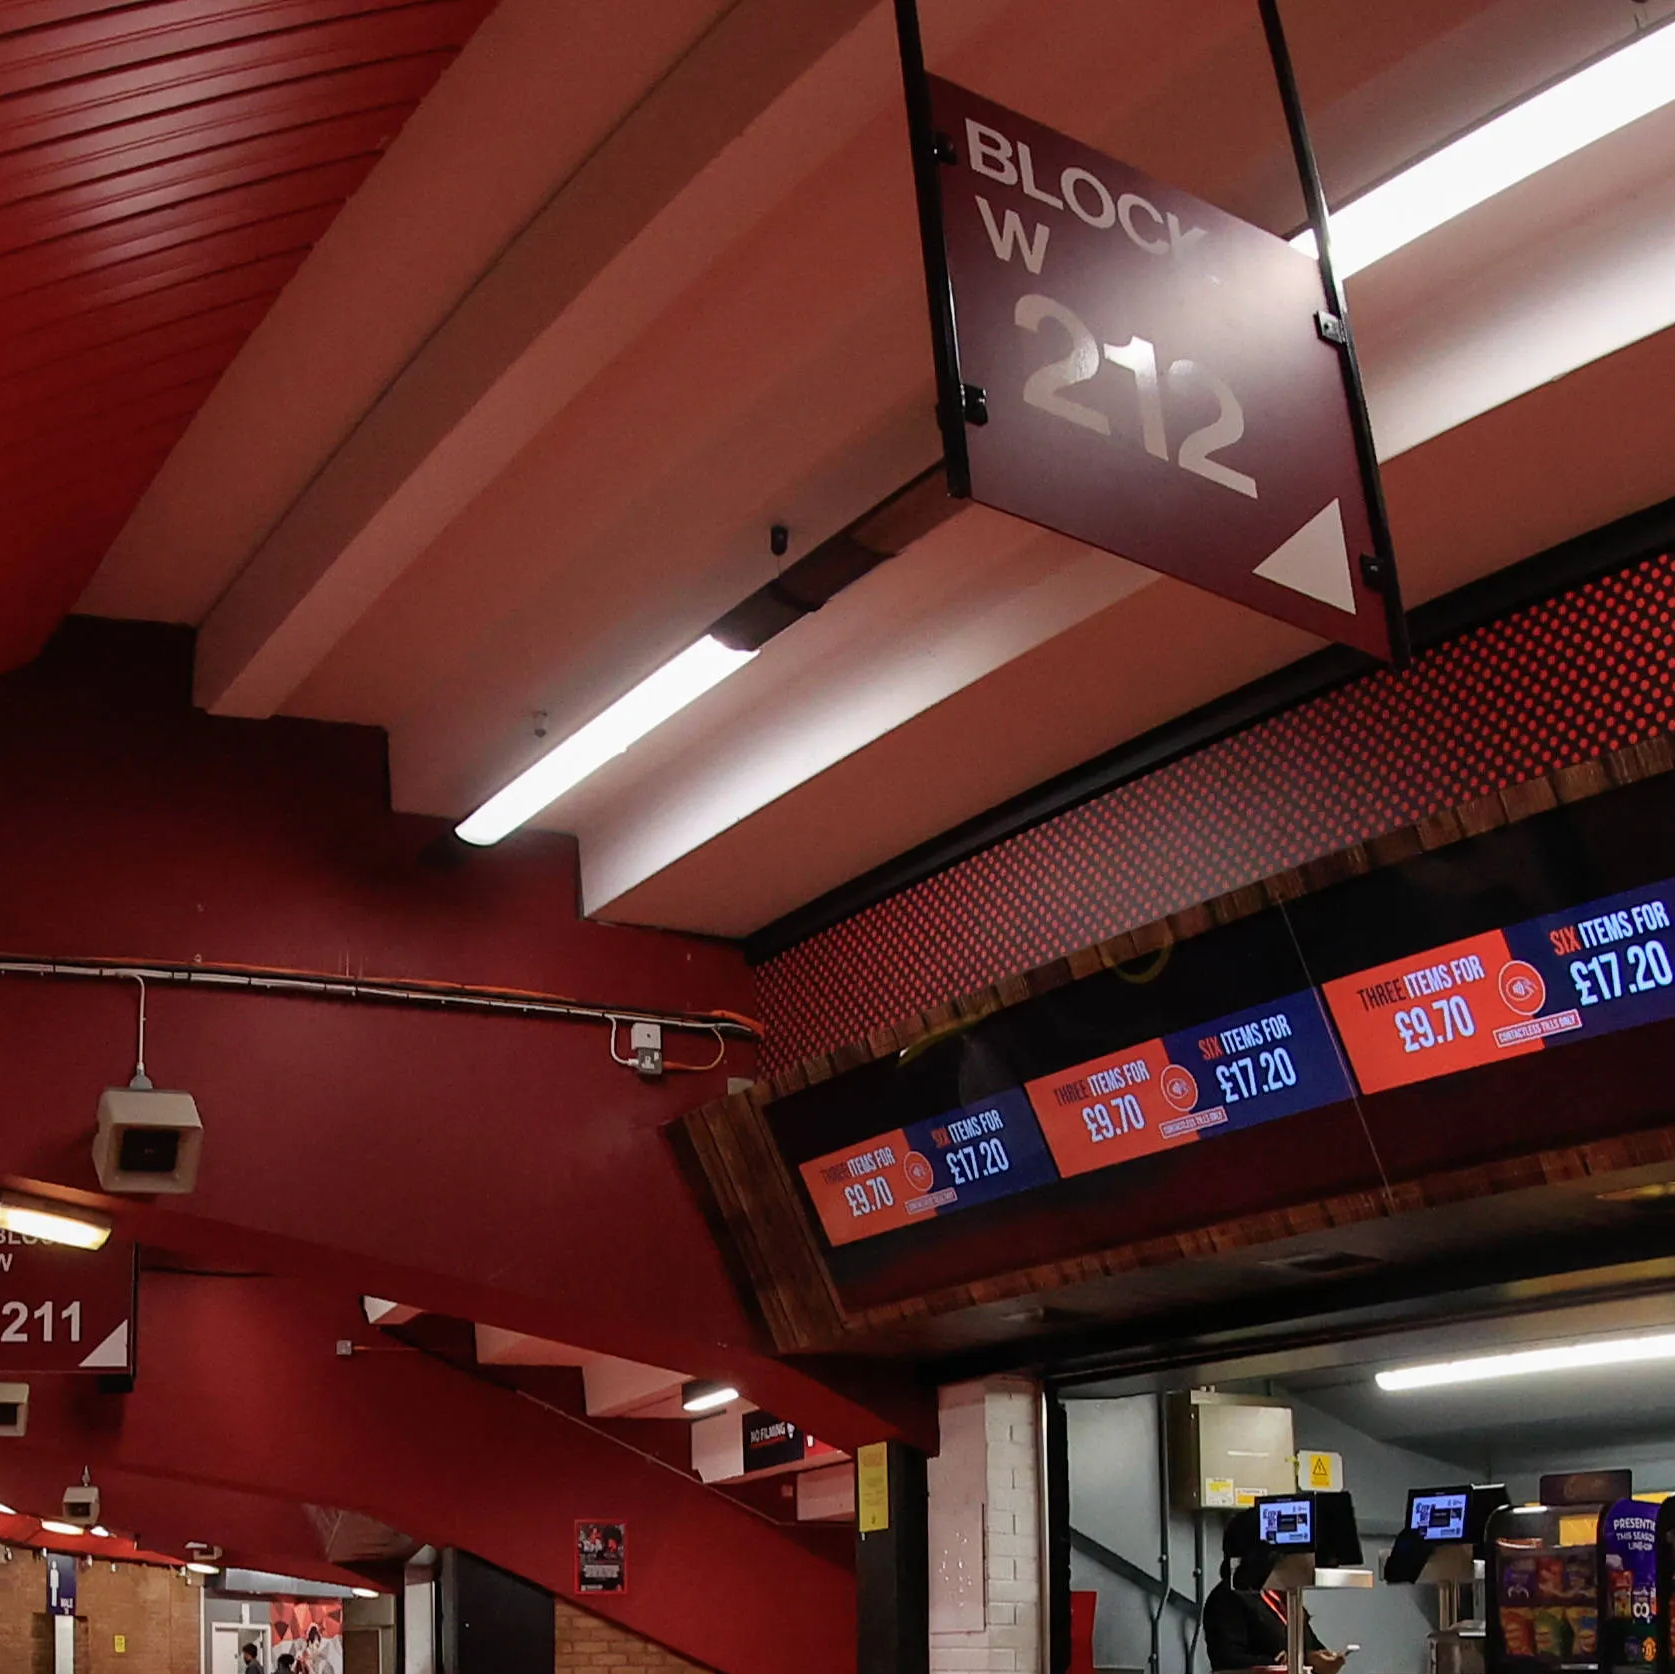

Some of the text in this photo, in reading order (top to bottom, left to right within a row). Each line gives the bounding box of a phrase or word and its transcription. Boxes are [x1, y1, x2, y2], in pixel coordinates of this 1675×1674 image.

[965, 117, 1220, 286] BLOCK
[976, 195, 1050, 274] W
[1014, 294, 1258, 499] 212
[1549, 900, 1671, 957] SIX ITEMS FOR
[1356, 954, 1486, 1011] THREE ITEMS FOR
[1569, 939, 1674, 1007] £17.20
[1198, 1013, 1293, 1061] SIX ITEMS FOR
[1393, 995, 1476, 1053] £9.70
[1053, 1060, 1151, 1106] THREE ITEMS FOR
[1215, 1047, 1297, 1103] £17.20
[947, 1116, 982, 1143] ITEMS
[978, 1109, 1004, 1133] FOR
[1082, 1094, 1146, 1143] £9.70
[847, 1152, 877, 1177] ITEMS
[873, 1146, 896, 1168] FOR
[946, 1137, 1009, 1185] £17.20
[844, 1176, 894, 1217] £9.70
[1, 1301, 81, 1342] 211
[750, 1422, 786, 1443] NO FILMING
